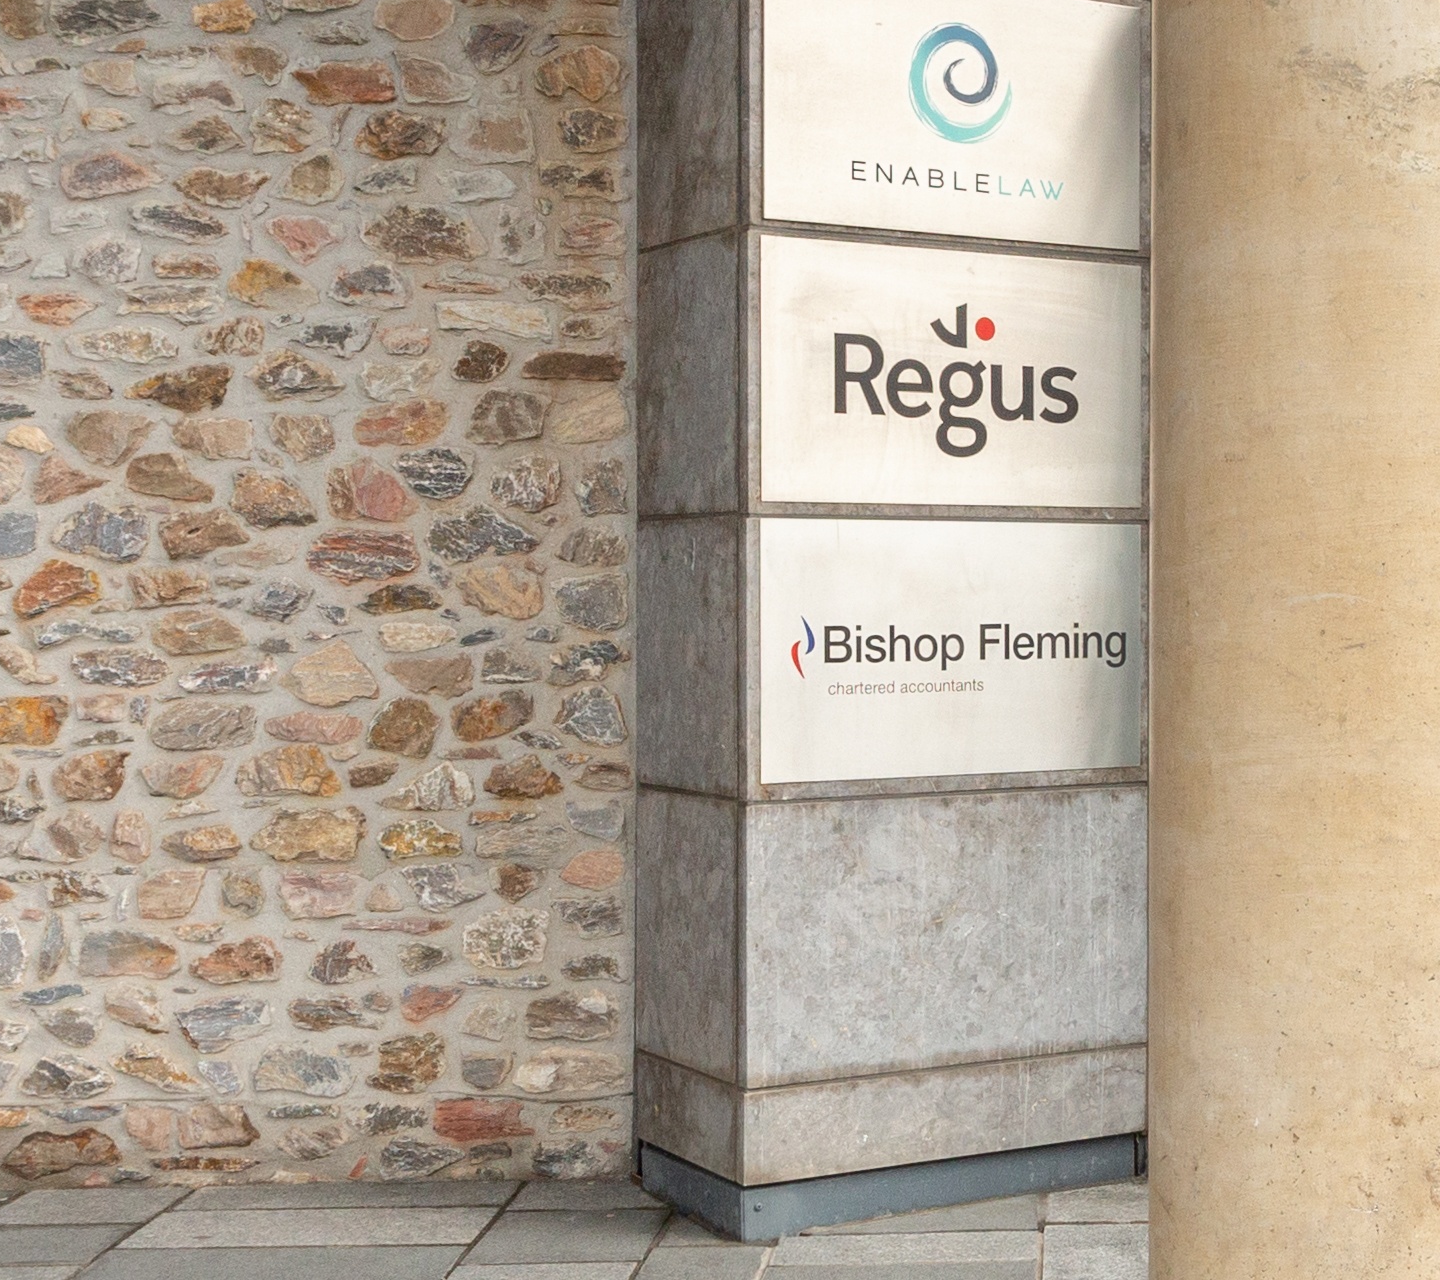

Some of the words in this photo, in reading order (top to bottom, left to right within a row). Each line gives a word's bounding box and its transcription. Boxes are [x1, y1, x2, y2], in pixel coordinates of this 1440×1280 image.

[834, 332, 1079, 458] Regus
[823, 624, 965, 671] Bishop
[978, 622, 1127, 669] Fleming
[827, 680, 896, 696] chartered
[900, 678, 984, 695] accountants
